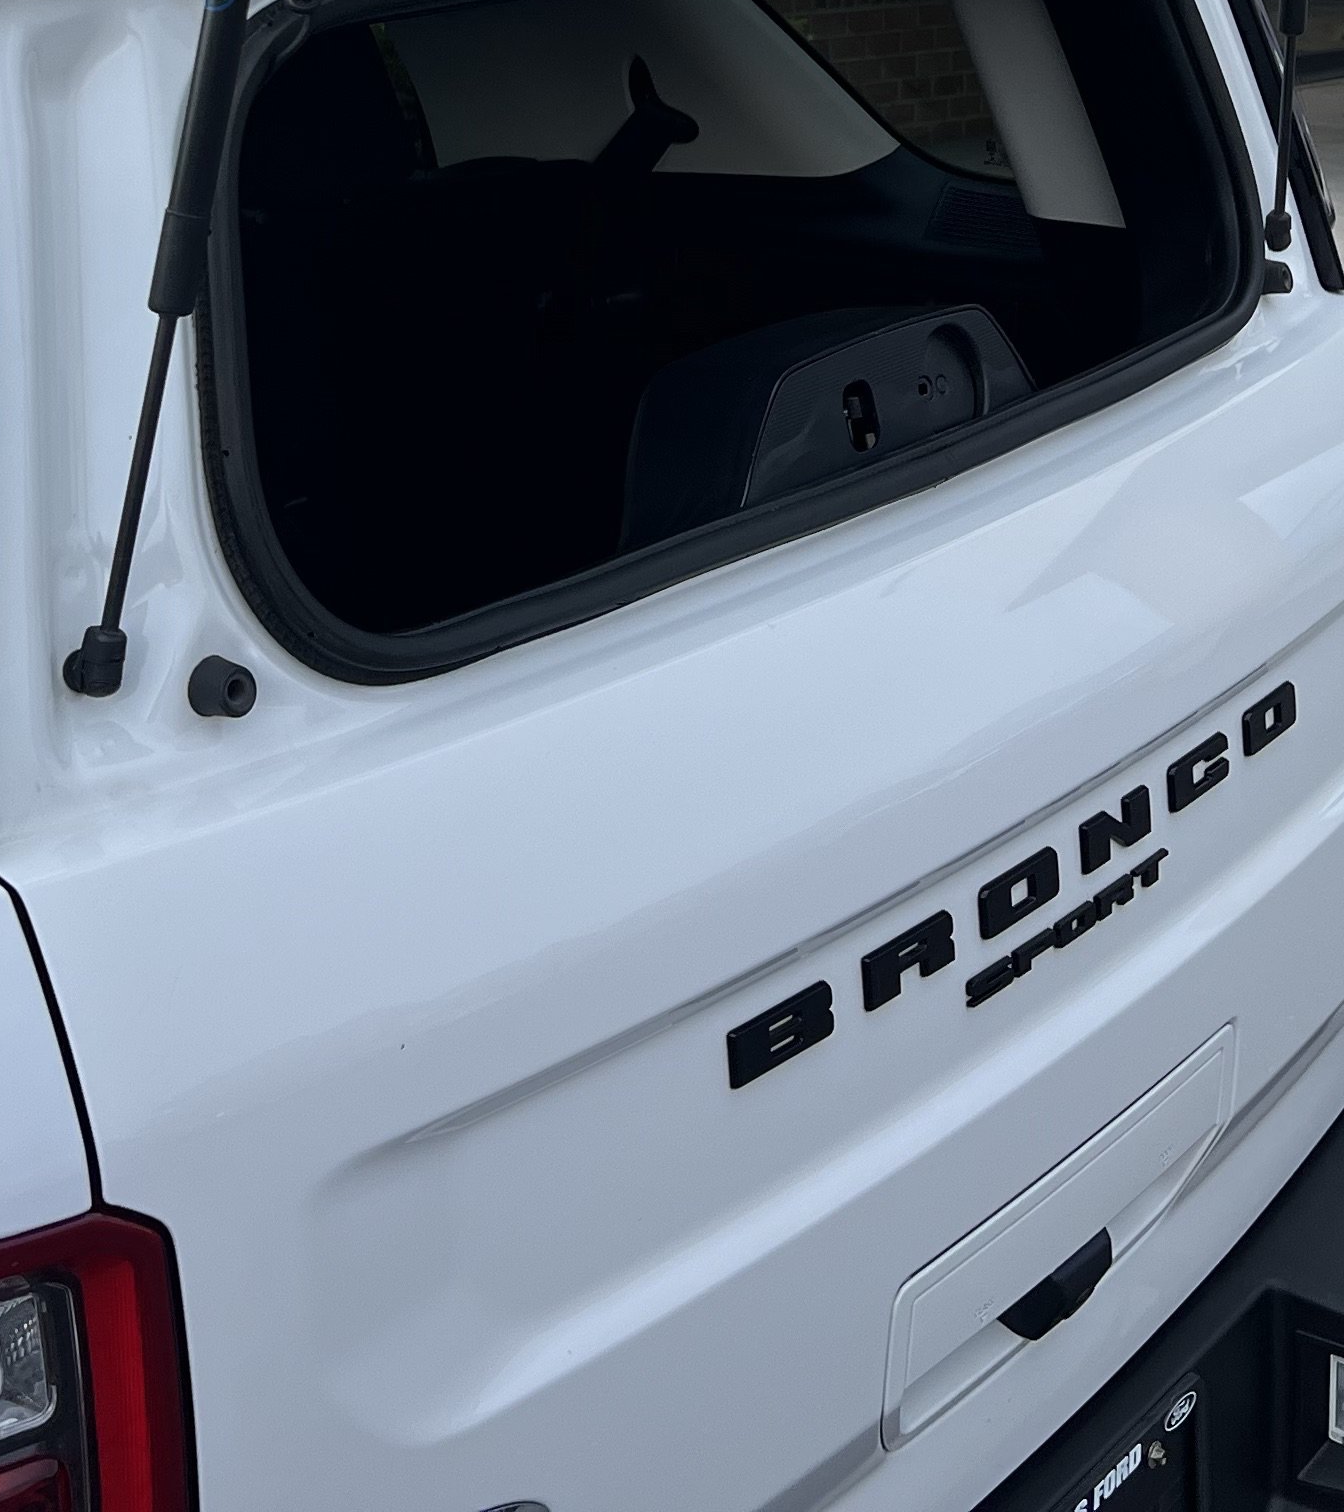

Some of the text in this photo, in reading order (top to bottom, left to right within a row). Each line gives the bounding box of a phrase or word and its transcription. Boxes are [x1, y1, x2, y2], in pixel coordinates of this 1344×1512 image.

[725, 680, 1297, 1090] BRONCO
[965, 847, 1169, 1008] SPORT
[1093, 1443, 1142, 1511] FORD
